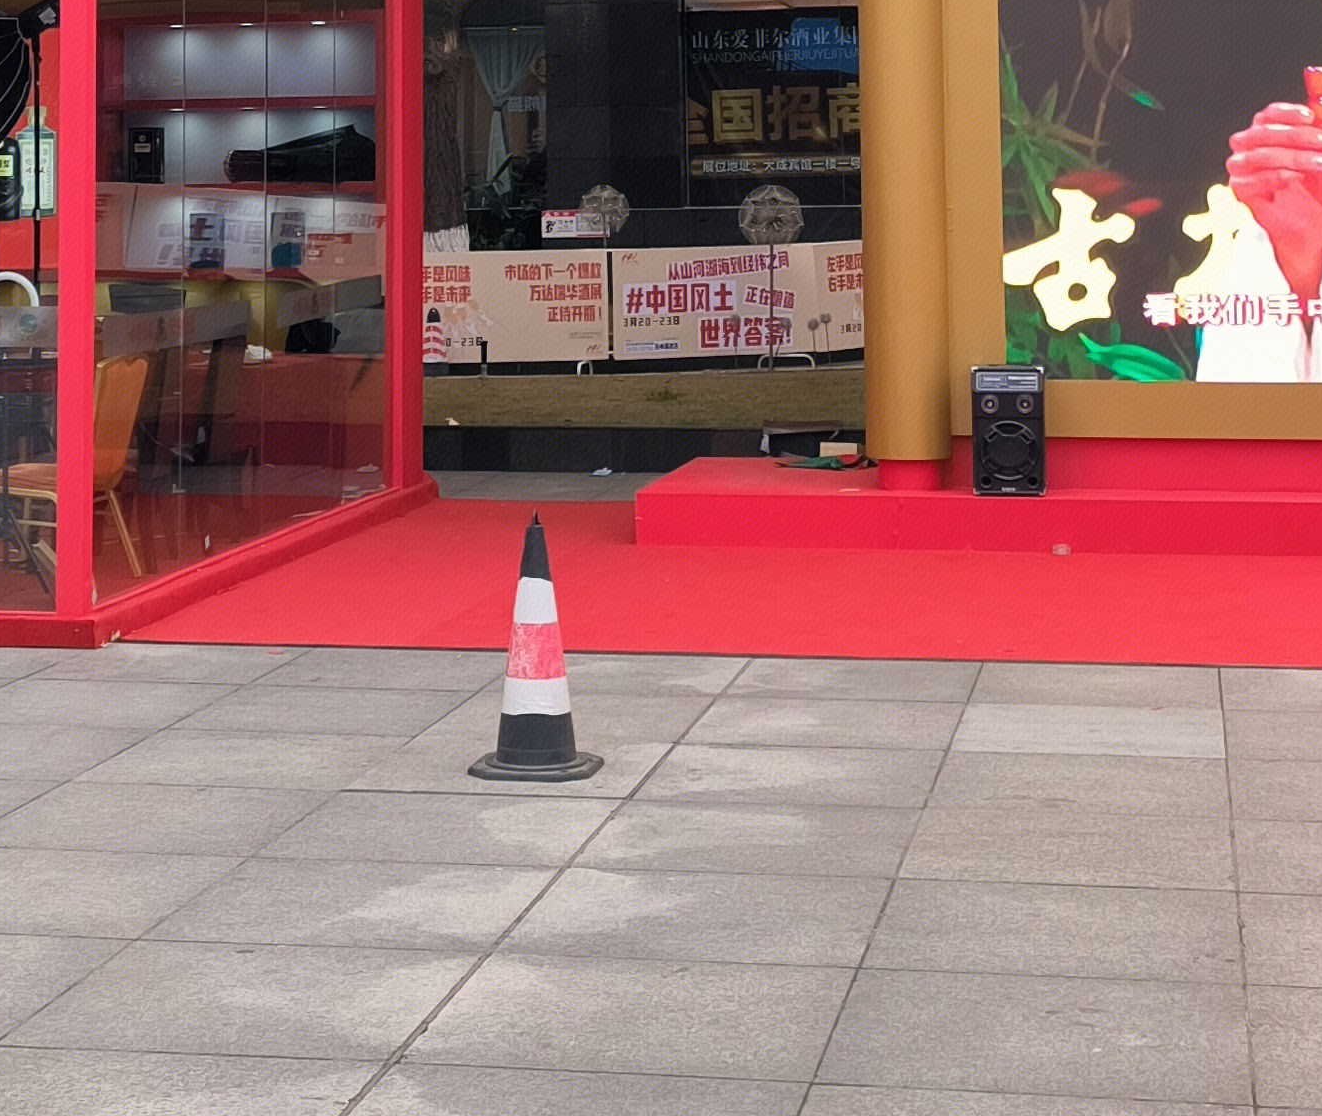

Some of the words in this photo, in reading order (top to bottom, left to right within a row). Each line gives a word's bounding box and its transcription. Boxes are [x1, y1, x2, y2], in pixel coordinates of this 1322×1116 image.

[692, 25, 858, 49] 山东爱菲尔酒业集
[626, 282, 734, 315] #中国风土
